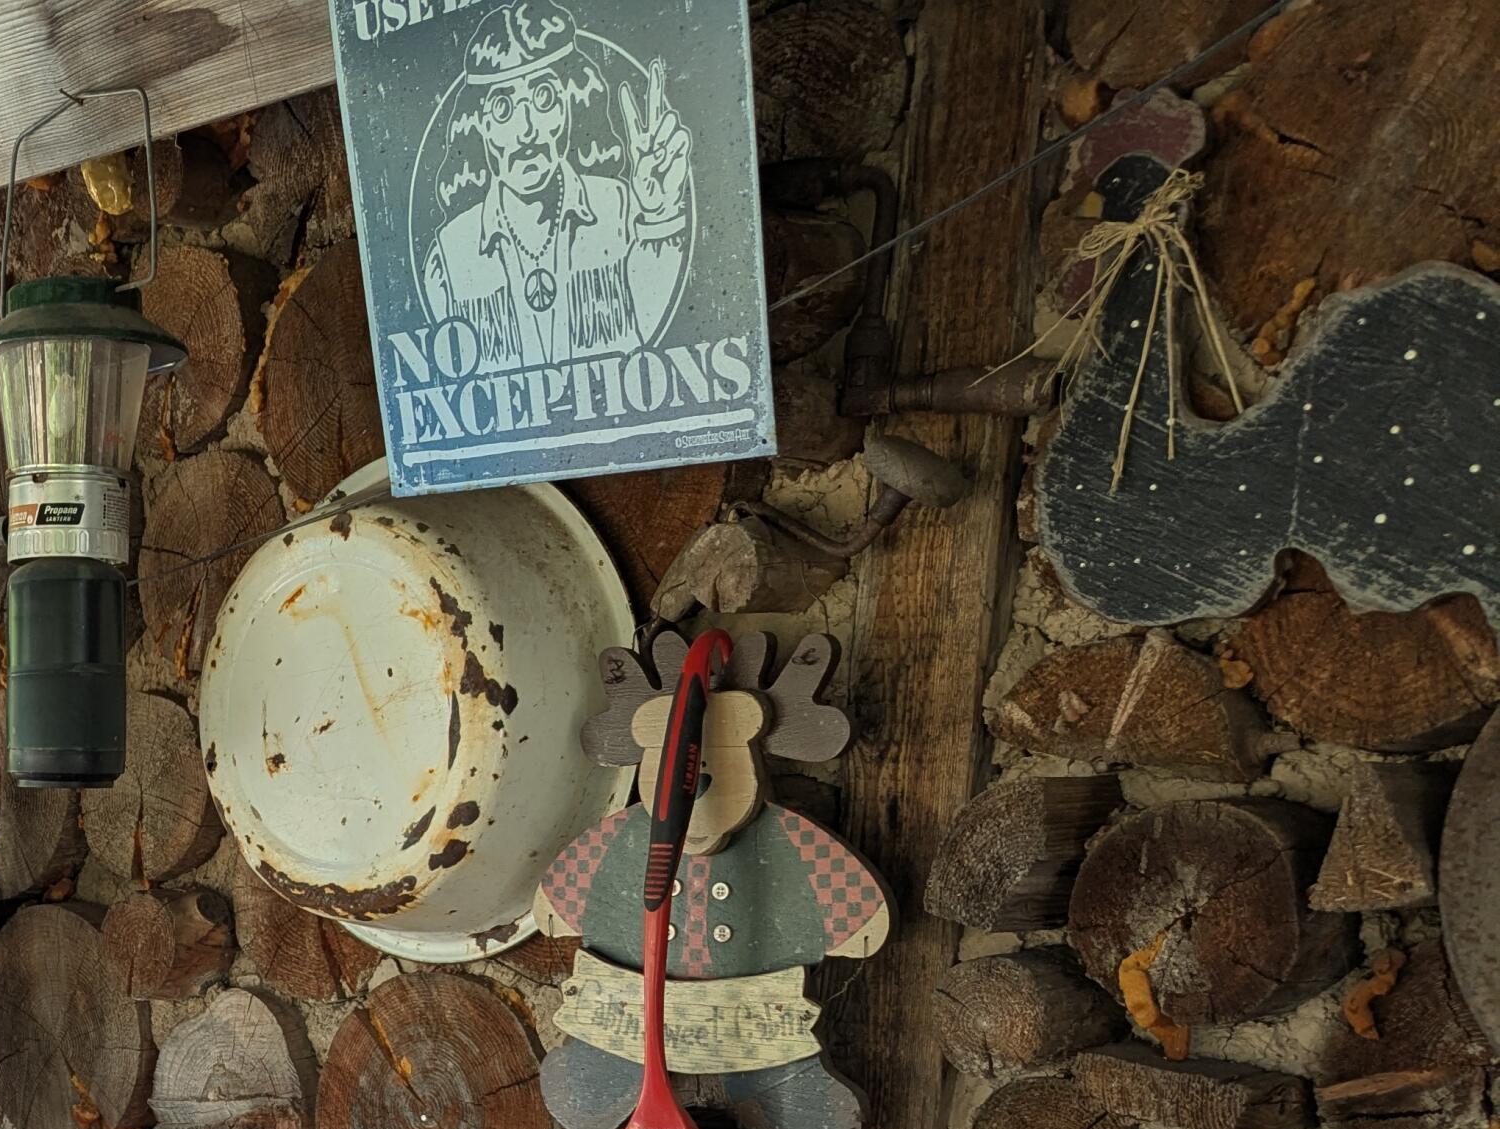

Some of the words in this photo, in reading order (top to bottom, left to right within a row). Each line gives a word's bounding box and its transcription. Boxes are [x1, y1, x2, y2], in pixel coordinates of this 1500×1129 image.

[387, 319, 479, 388] NO
[394, 336, 752, 446] EXCEPTIONS
[43, 505, 78, 516] Propane
